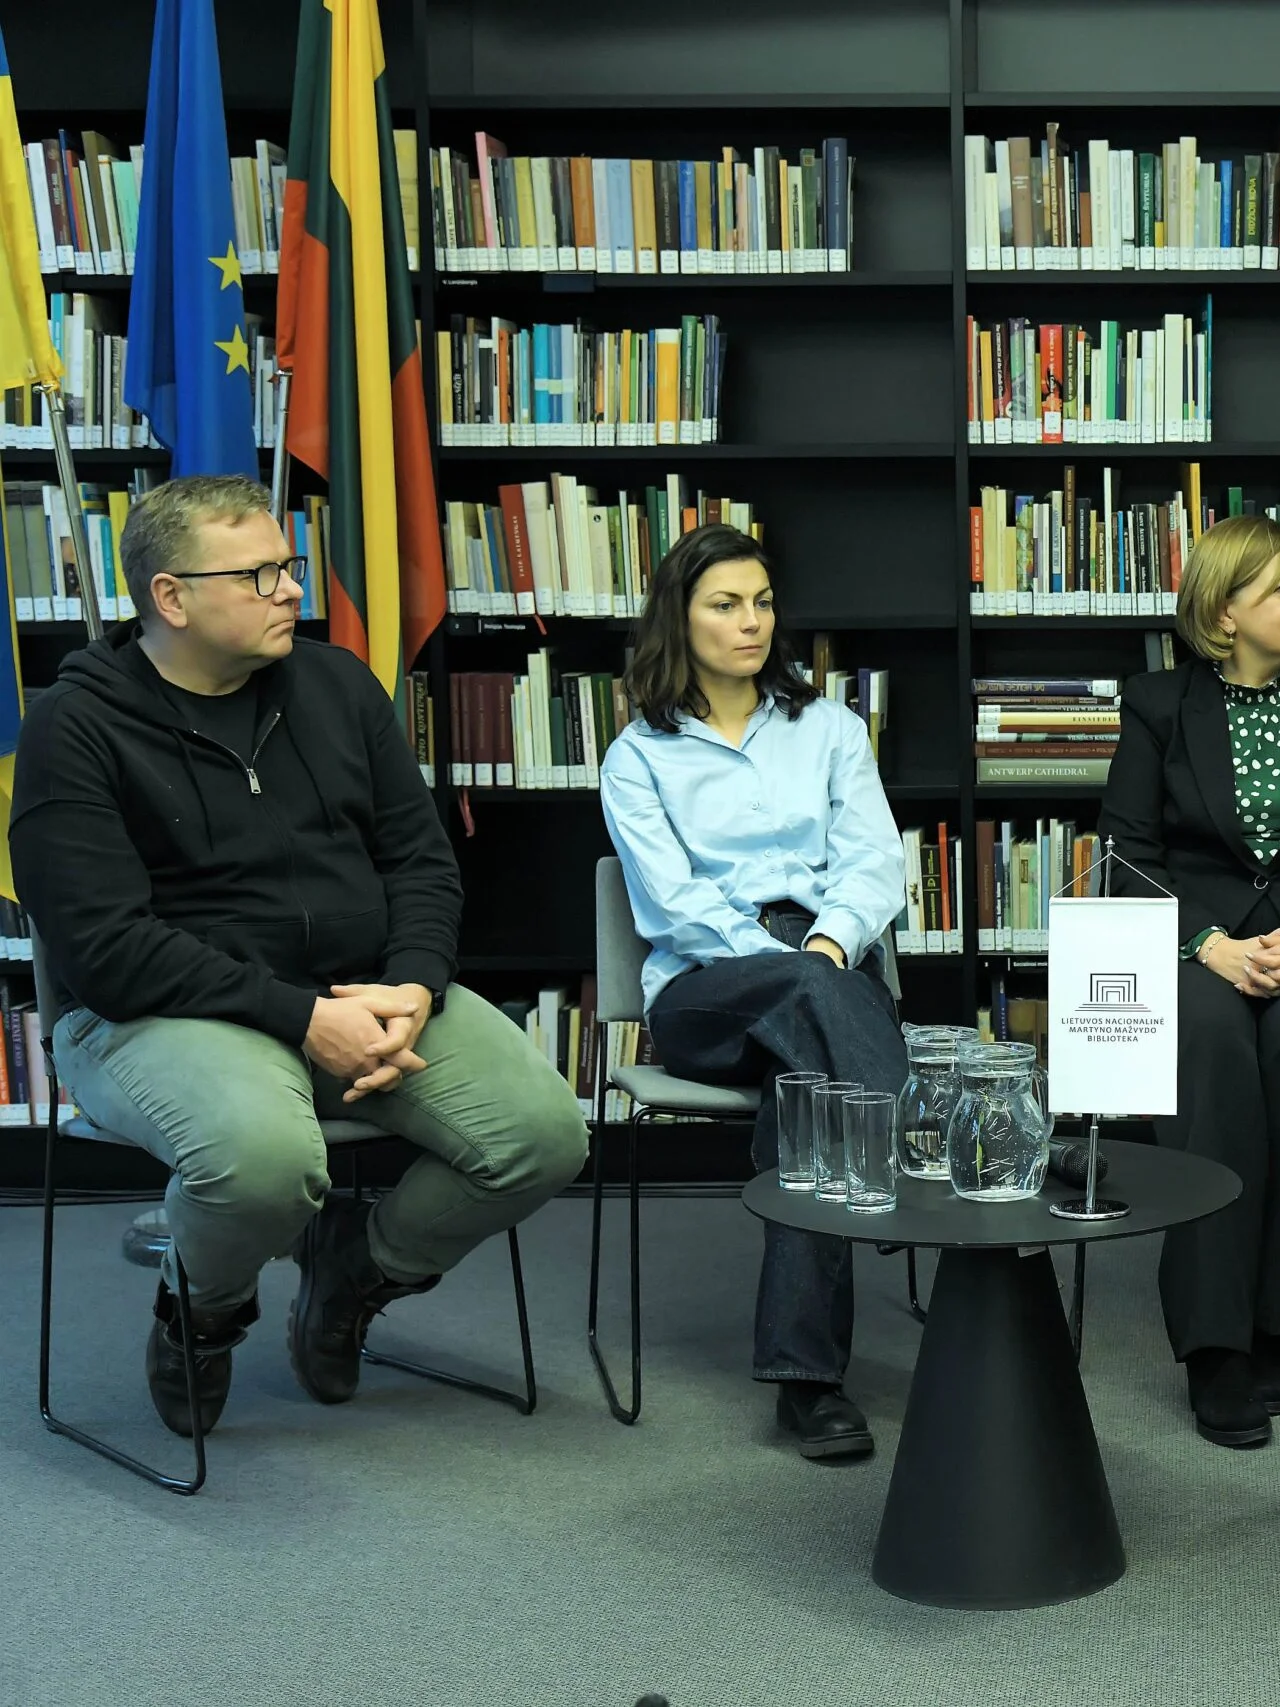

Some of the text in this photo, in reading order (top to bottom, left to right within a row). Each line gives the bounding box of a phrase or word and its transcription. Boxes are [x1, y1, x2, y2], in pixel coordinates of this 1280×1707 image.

[1248, 179, 1257, 200] KOVA
[987, 767, 1089, 776] ANTWERP CATHEDRAL
[1061, 1017, 1164, 1025] LIETUVOS NACIONALINĖ
[1114, 1025, 1157, 1034] MAŽVYDO
[1087, 1035, 1139, 1043] BIBLIOTEKA
